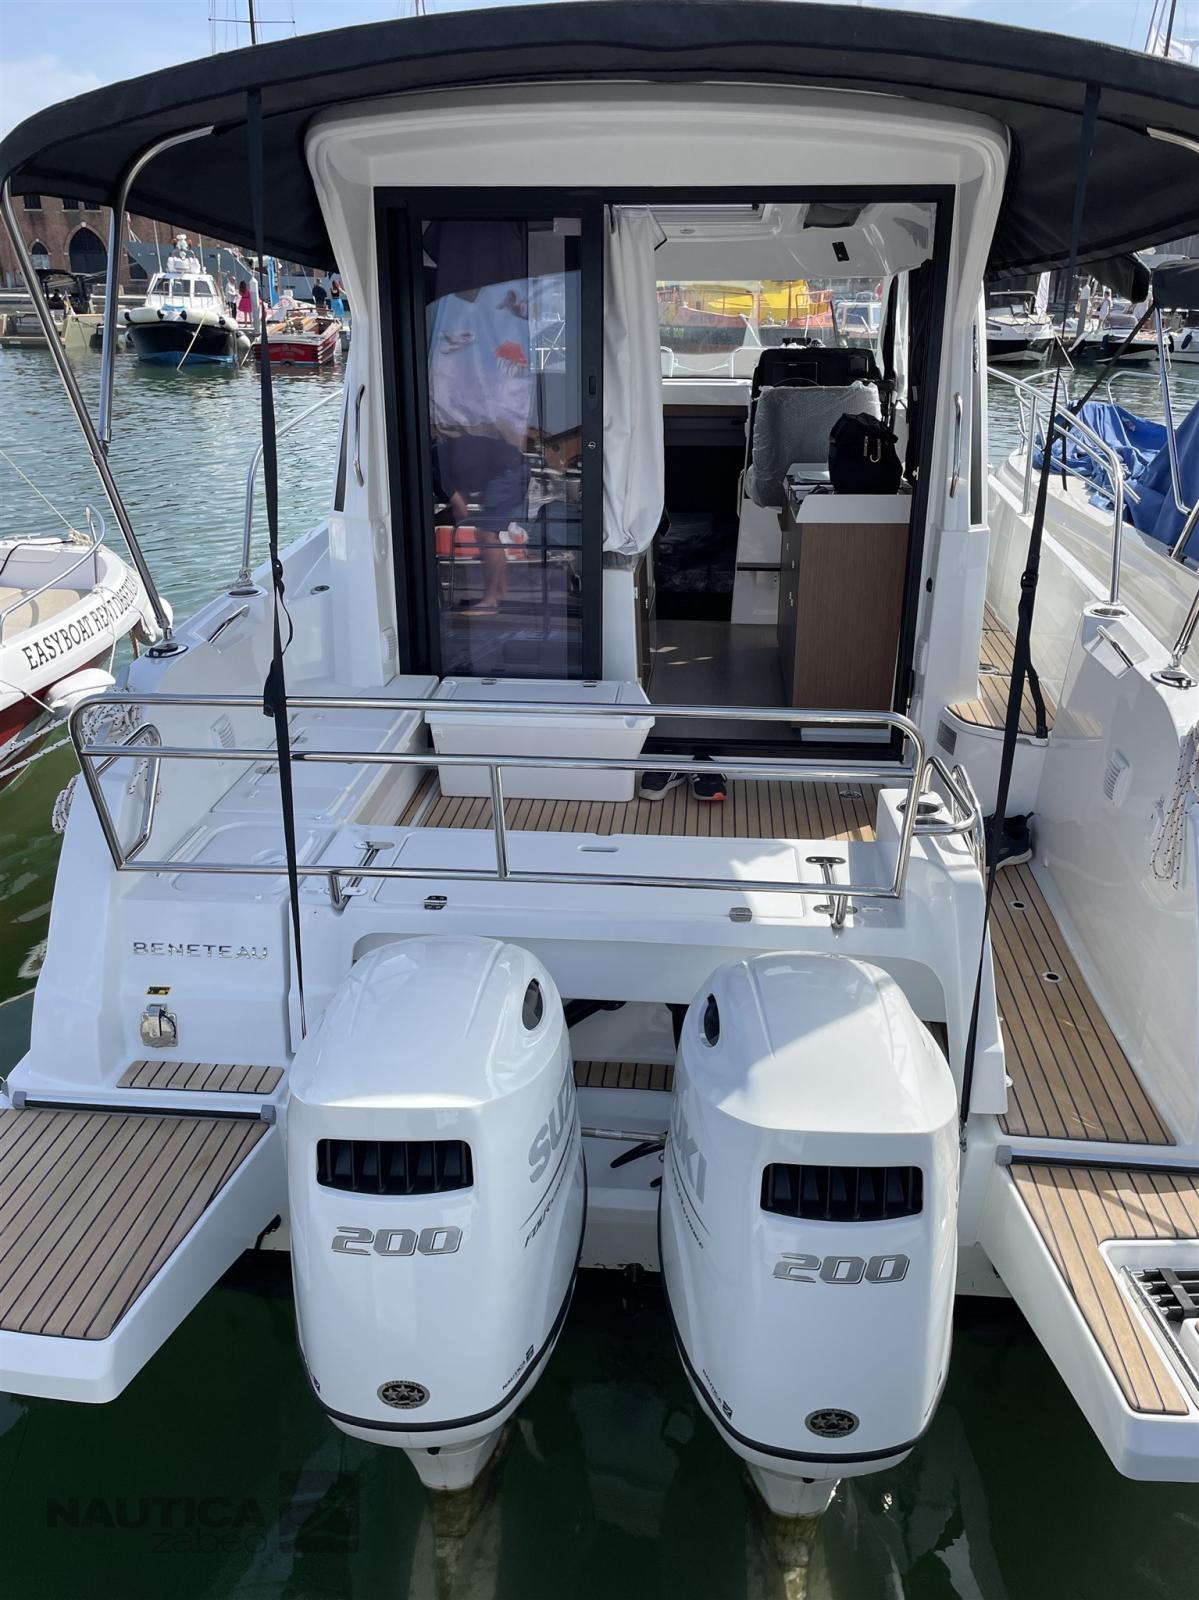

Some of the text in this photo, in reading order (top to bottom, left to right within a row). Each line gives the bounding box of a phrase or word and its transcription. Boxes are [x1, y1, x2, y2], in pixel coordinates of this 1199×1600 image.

[21, 615, 95, 670] EASYBOAT
[89, 600, 119, 632] RENT
[133, 941, 268, 960] BENETEAU
[331, 1226, 463, 1256] 200
[772, 1252, 910, 1284] 200
